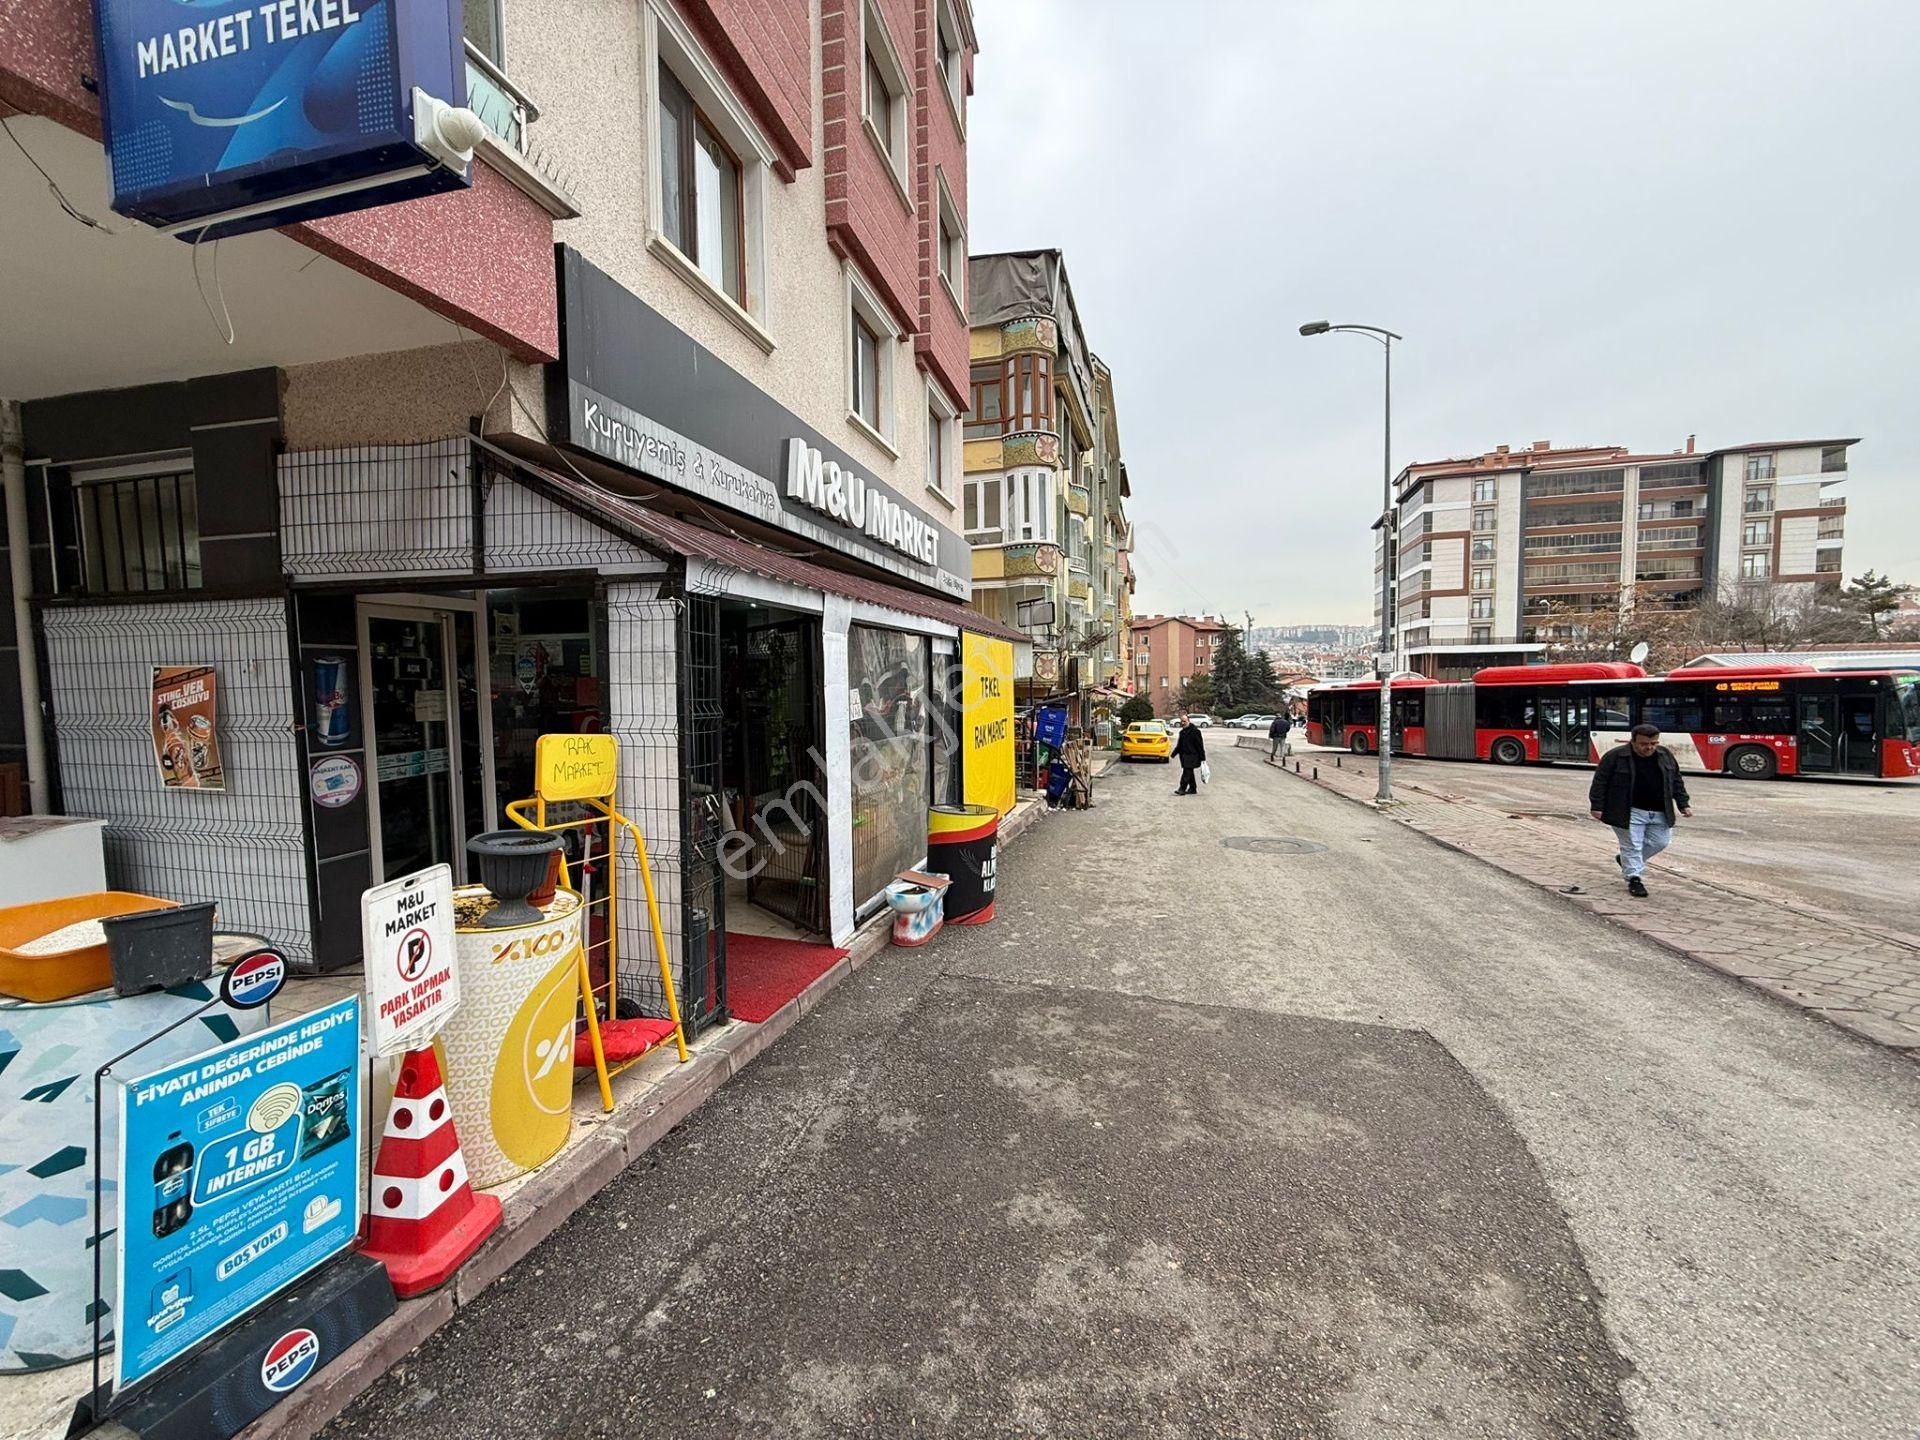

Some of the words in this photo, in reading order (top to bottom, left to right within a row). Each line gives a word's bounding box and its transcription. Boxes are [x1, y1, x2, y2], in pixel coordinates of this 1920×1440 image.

[137, 10, 252, 79] MARKET
[259, 0, 360, 44] TEKEL
[584, 398, 686, 477] Kuruyemiş
[710, 459, 776, 510] Kurukahve
[787, 437, 866, 529] M&U
[865, 488, 940, 567] MARKET
[980, 677, 1001, 698] TEKEL
[563, 737, 597, 756] RAK
[974, 722, 987, 750] RAK
[986, 718, 1008, 747] MARKET
[553, 761, 604, 784] MARKET
[385, 903, 437, 937] MARKET
[396, 890, 425, 914] M&U
[232, 966, 282, 991] PEPSI
[380, 993, 411, 1019] PARK
[411, 966, 451, 1004] YAPMAK
[392, 989, 443, 1029] YASAKTIR
[136, 1070, 198, 1107] FİYATI
[201, 1030, 298, 1079] DEĞERİNDE
[301, 1008, 354, 1039] HEDİYE
[180, 1068, 253, 1107] ANINDA
[255, 1037, 324, 1073] CEBİNDE
[208, 1103, 226, 1117] TEK
[306, 1090, 345, 1115] Doritos
[225, 1146, 238, 1169] 1
[243, 1133, 276, 1162] GB
[242, 1195, 267, 1211] VEYA
[294, 1168, 313, 1184] BOY
[224, 1249, 251, 1275] BOŞ
[252, 1228, 283, 1254] YOK!
[265, 1338, 316, 1382] PEPSI
